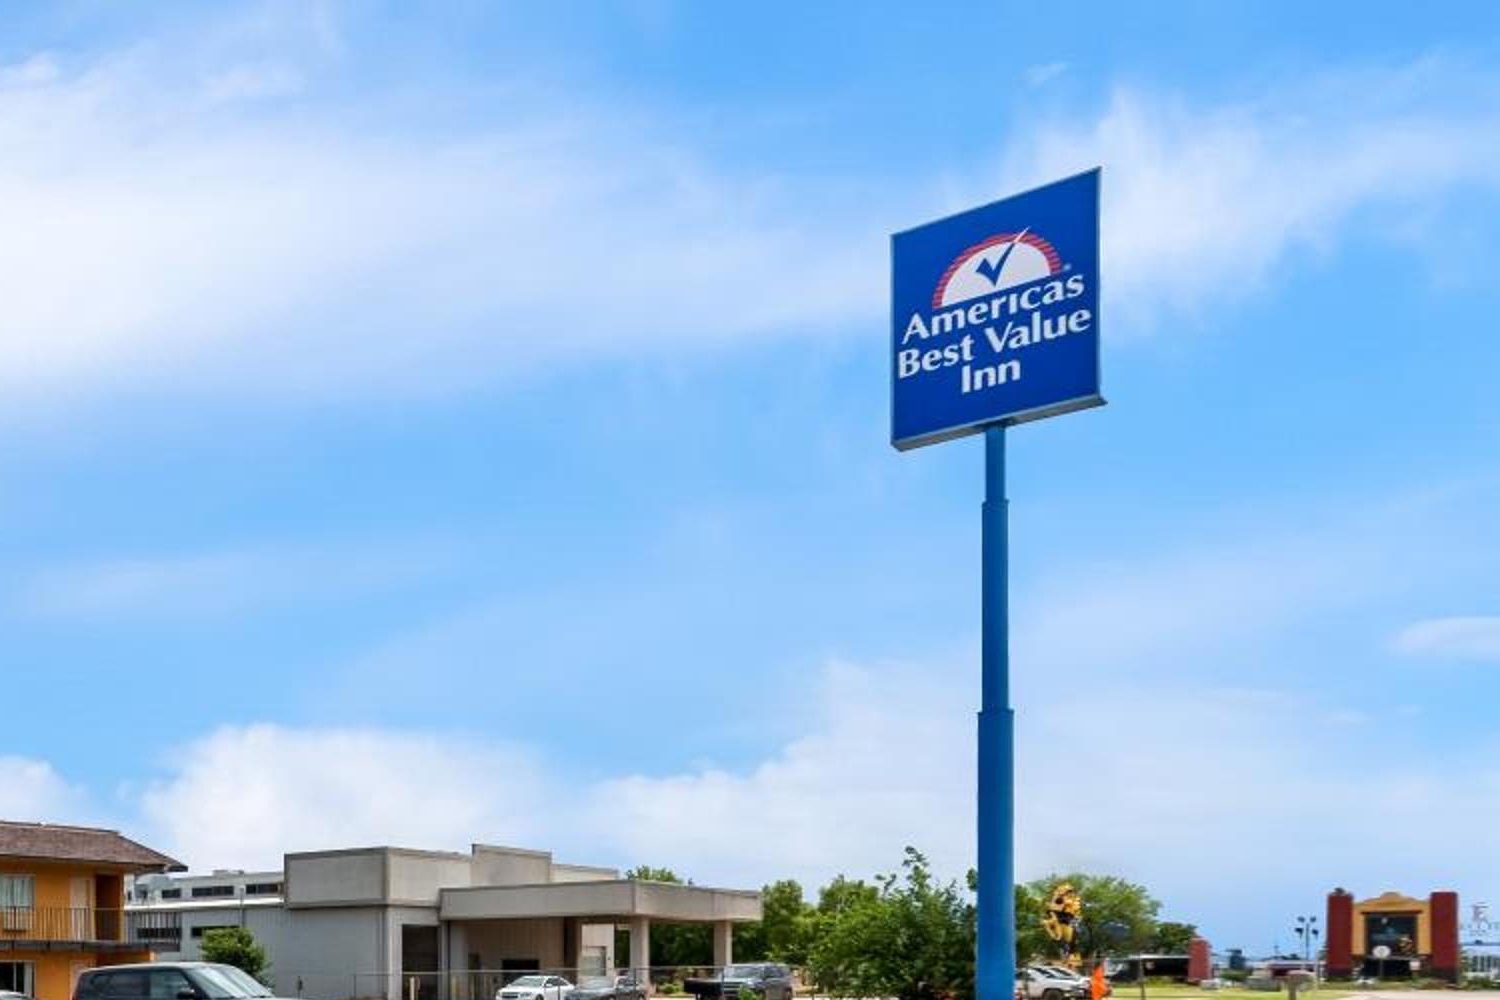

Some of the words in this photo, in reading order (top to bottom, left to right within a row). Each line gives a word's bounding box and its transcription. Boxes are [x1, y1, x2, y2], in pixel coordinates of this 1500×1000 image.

[898, 334, 975, 379] Best
[984, 308, 1092, 353] Value
[902, 273, 1085, 345] Americas
[961, 359, 1021, 393] Inn
